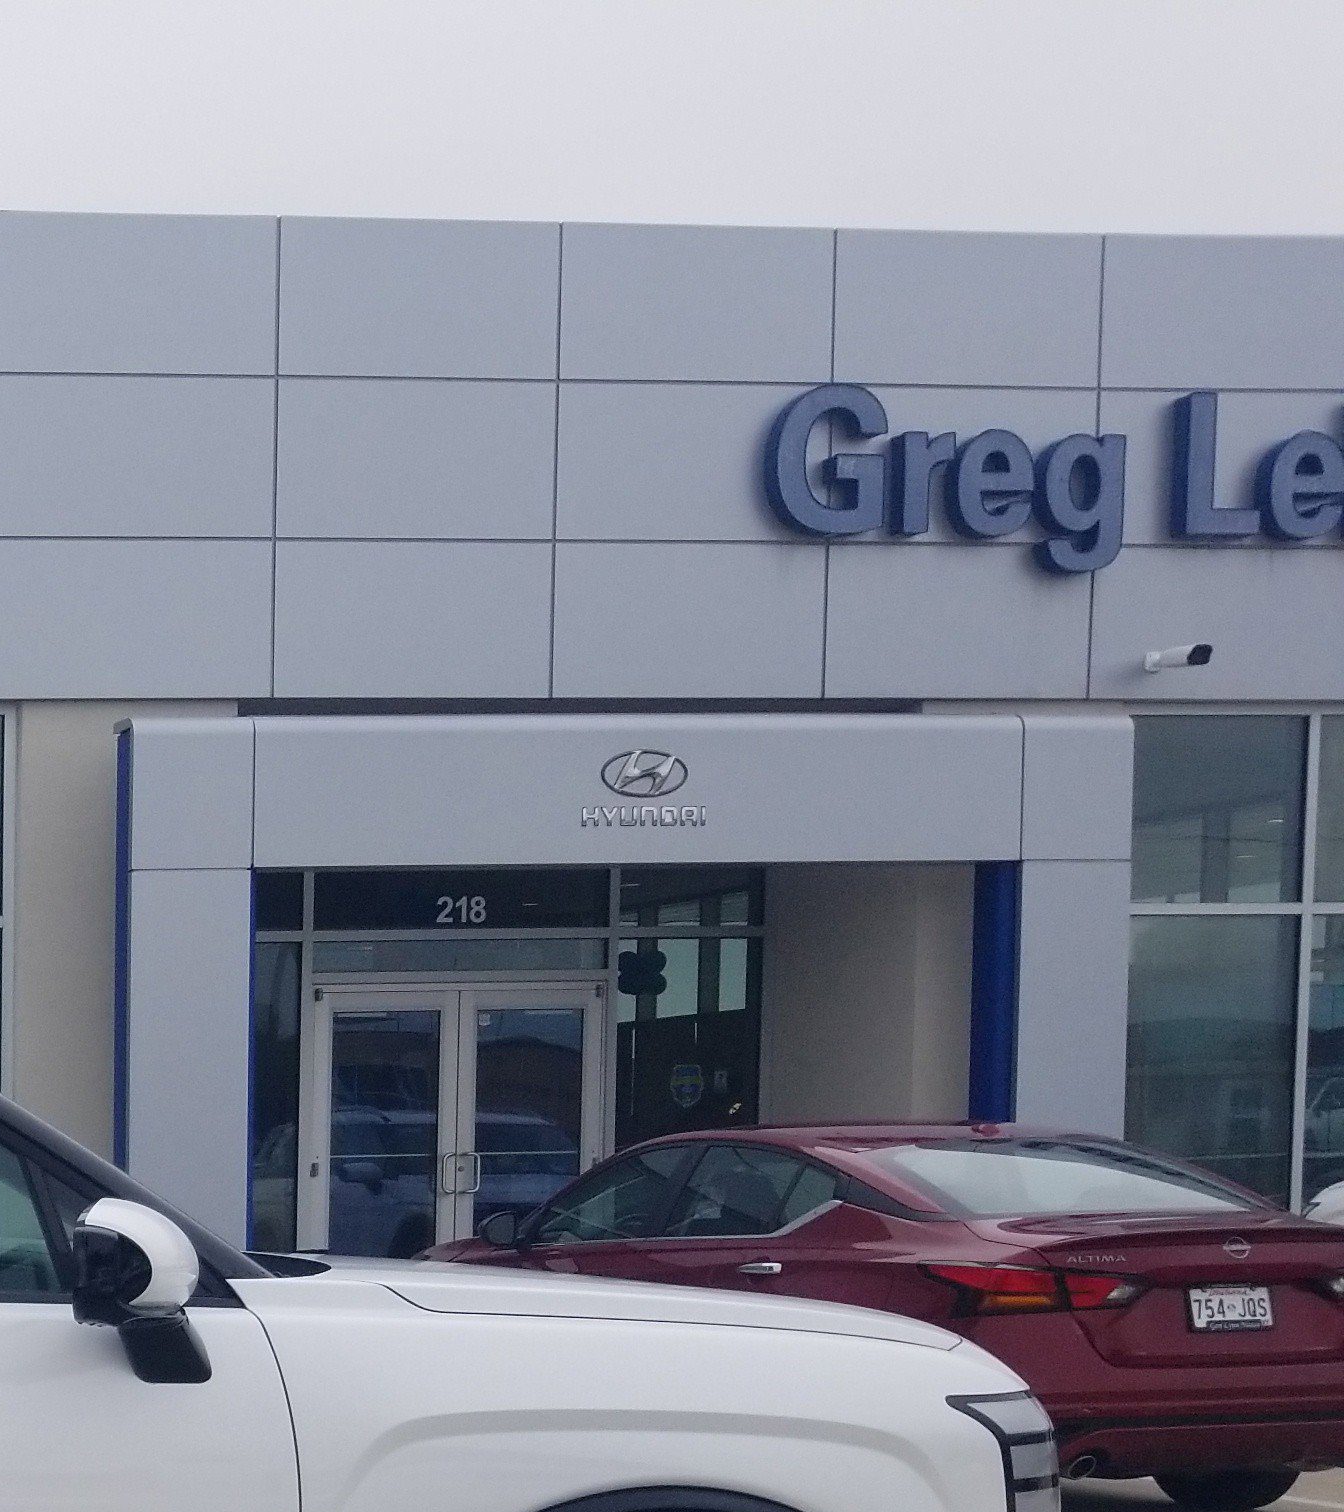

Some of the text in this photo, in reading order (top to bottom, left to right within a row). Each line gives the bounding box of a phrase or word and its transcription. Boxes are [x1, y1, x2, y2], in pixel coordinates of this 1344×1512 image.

[767, 383, 1126, 572] Greg
[581, 805, 706, 827] HYUNDAI
[436, 896, 487, 923] 218
[1066, 1255, 1127, 1263] ALTIMA
